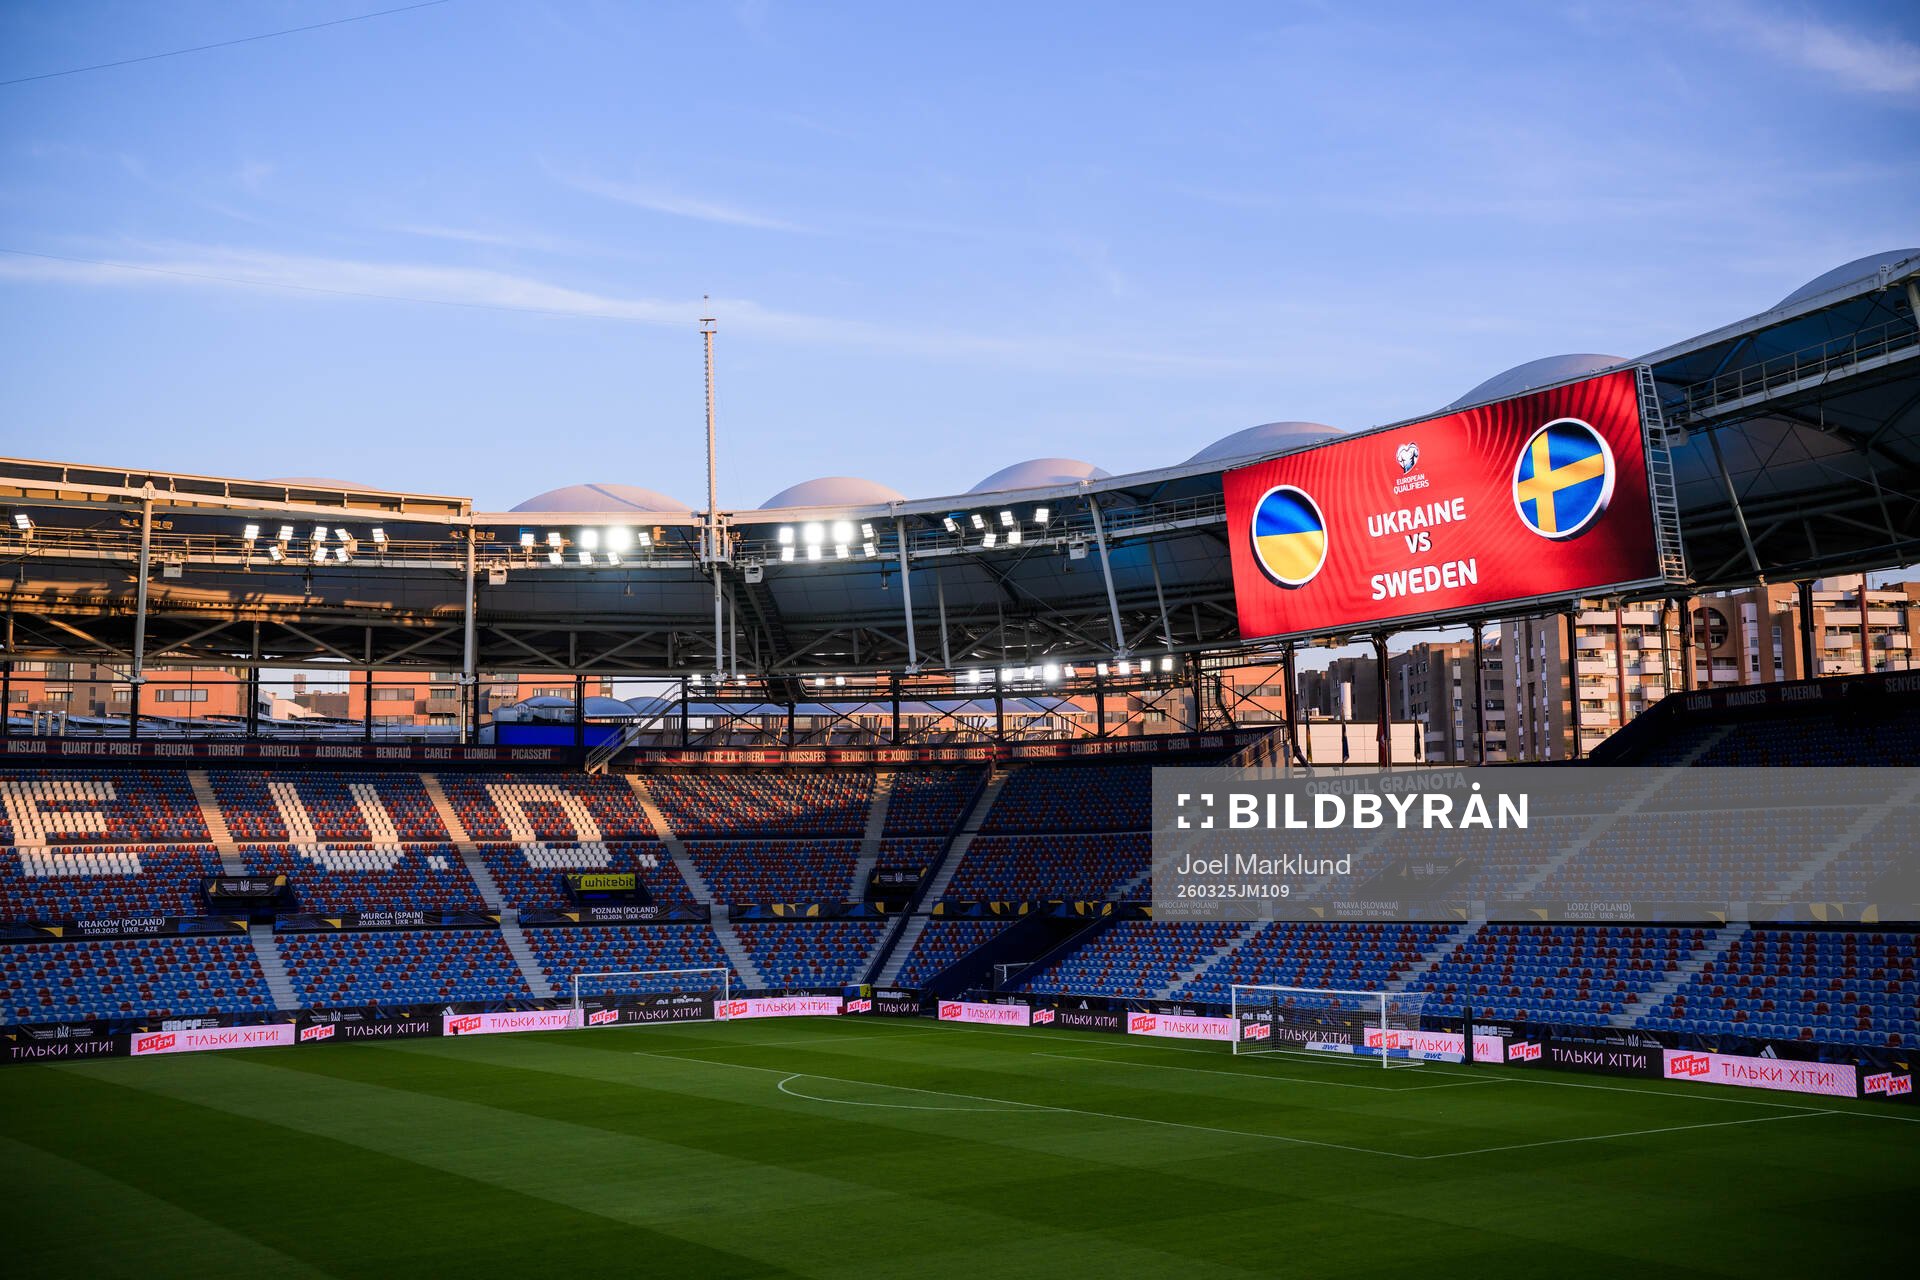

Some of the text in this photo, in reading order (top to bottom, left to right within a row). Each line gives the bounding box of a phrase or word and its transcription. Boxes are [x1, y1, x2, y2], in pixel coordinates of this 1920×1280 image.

[1393, 480, 1429, 494] QUALIFIERS
[1396, 474, 1425, 486] EUROPEAN
[1368, 497, 1466, 538] UKRAINE
[1405, 531, 1432, 554] VS
[1371, 558, 1478, 600] SWEDEN
[1726, 690, 1766, 707] MANISES
[1781, 685, 1823, 701] PATERNA
[8, 740, 551, 760] MISLATA QUART DE POBLET REQUENA TORRENT XIRIVELLA ALBORACHE BENIFAIÓ CARLET LLOMBAI PICASSENT
[681, 751, 710, 762] ALBALAT
[714, 751, 724, 762] DE
[727, 751, 736, 762] LA
[738, 751, 765, 762] RIBERA
[780, 751, 826, 762] ALMUSSAFES
[841, 751, 874, 762] BENICULL
[877, 750, 888, 761] DE
[929, 748, 985, 760] FUENTERROBLES
[1012, 745, 1057, 757] MONTSERRAT
[1071, 743, 1101, 756] CAUDETE
[1103, 742, 1113, 753] DE
[1115, 741, 1128, 753] LAS
[1130, 740, 1158, 752] FUENTES
[1167, 739, 1190, 750] CHERA
[1305, 772, 1467, 798] ORGULL GRANOTA
[584, 876, 634, 889] whitebit
[591, 906, 659, 915] POZNAN (POLAND)
[1333, 901, 1399, 910] TRNAVA (SLOVAKIA)
[1567, 903, 1632, 912] LODZ (POLAND)
[78, 917, 166, 929] KRAKOW (POLAND)
[361, 911, 424, 921] MURCIA (SPAIN)
[628, 1007, 702, 1020] ТІЛЬКИ ХІТИ!
[756, 1001, 829, 1013] ТІЛЬКИ ХІТИ!
[967, 1007, 1020, 1020] ТІЛЬКИ ХІТИ!
[491, 1015, 571, 1028] ТІЛЬКИ ХІТИ!
[1061, 1013, 1118, 1027] ТІЛЬКИ ХІТИ!
[1163, 1020, 1228, 1034] ТІЛЬКИ ХІТИ!
[345, 1022, 429, 1036] ТІЛЬКИ ХІТИ!
[1279, 1028, 1350, 1043] ТІЛЬКИ ХІТИ!
[186, 1031, 279, 1046] ТІЛЬКИ ХІТИ!
[11, 1041, 113, 1058] ТІЛЬКИ ХІТИ!
[1458, 1042, 1488, 1054] ХТИ!
[1552, 1049, 1646, 1068] ТІЛЬКИ ХІТИ!
[1691, 1061, 1707, 1073] FM
[1722, 1063, 1835, 1086] ТІЛЬКИ ХІТИ!
